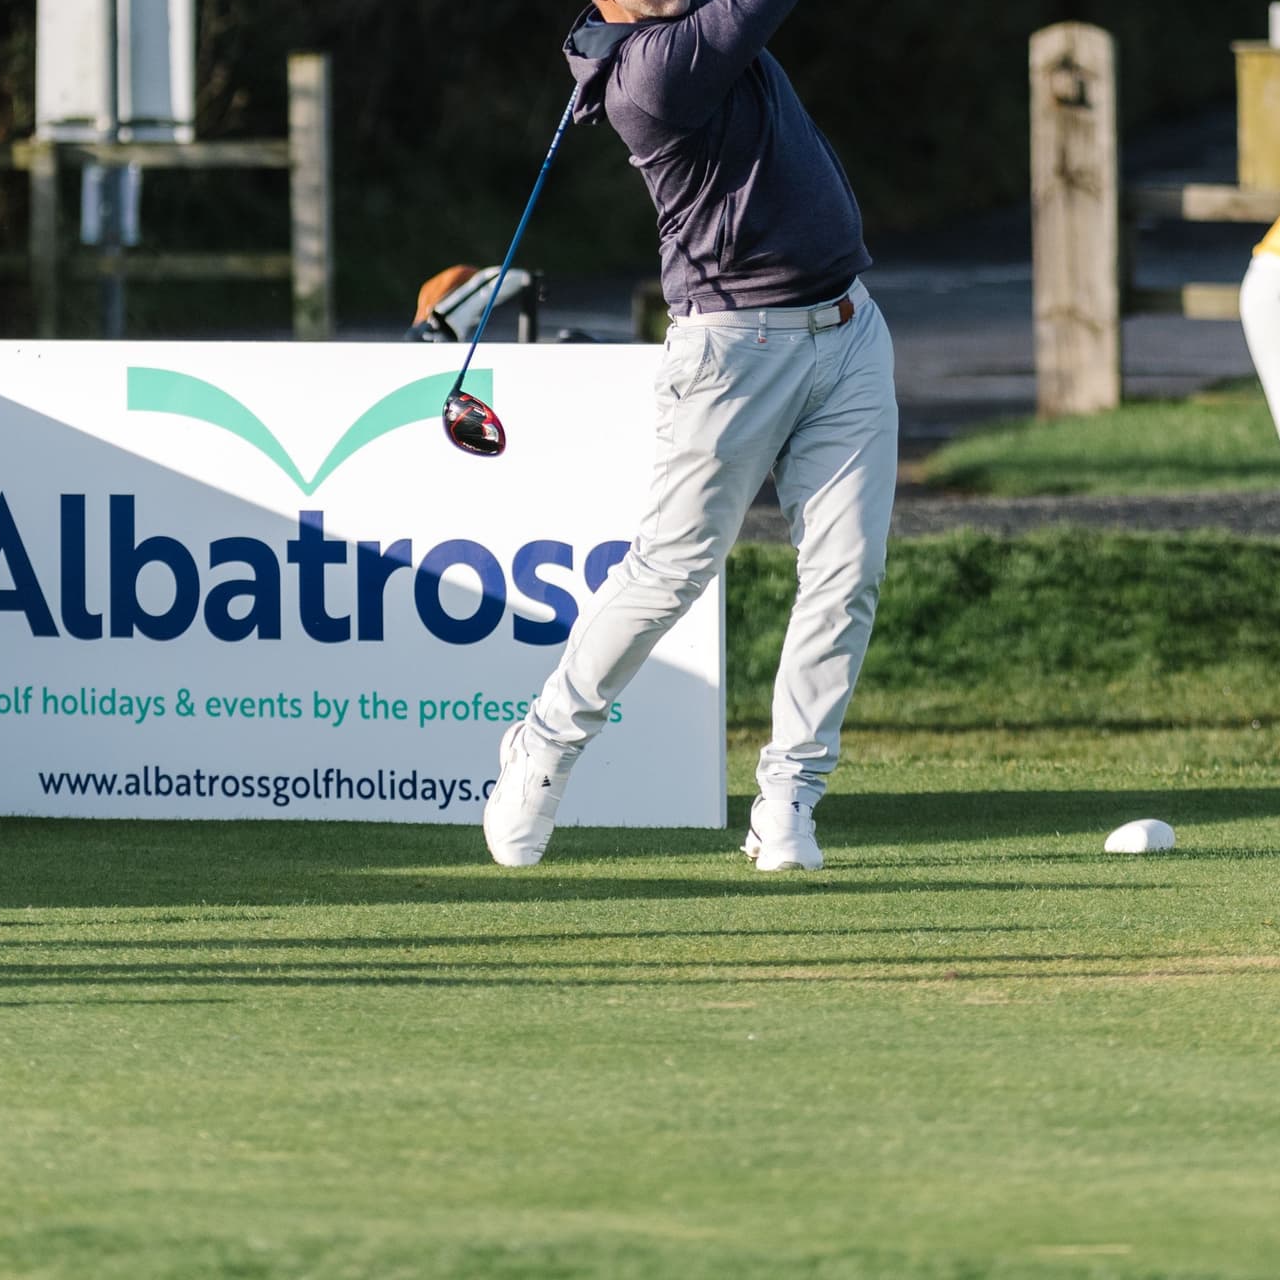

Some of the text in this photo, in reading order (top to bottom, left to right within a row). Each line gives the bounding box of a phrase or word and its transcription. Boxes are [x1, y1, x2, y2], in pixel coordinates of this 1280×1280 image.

[43, 687, 166, 724] holidays
[175, 688, 195, 717] &
[206, 692, 302, 719] events
[313, 691, 349, 728] by
[358, 692, 408, 721] the
[419, 692, 623, 728] professs
[38, 766, 497, 810] www.albatrossgolfholidays.c
